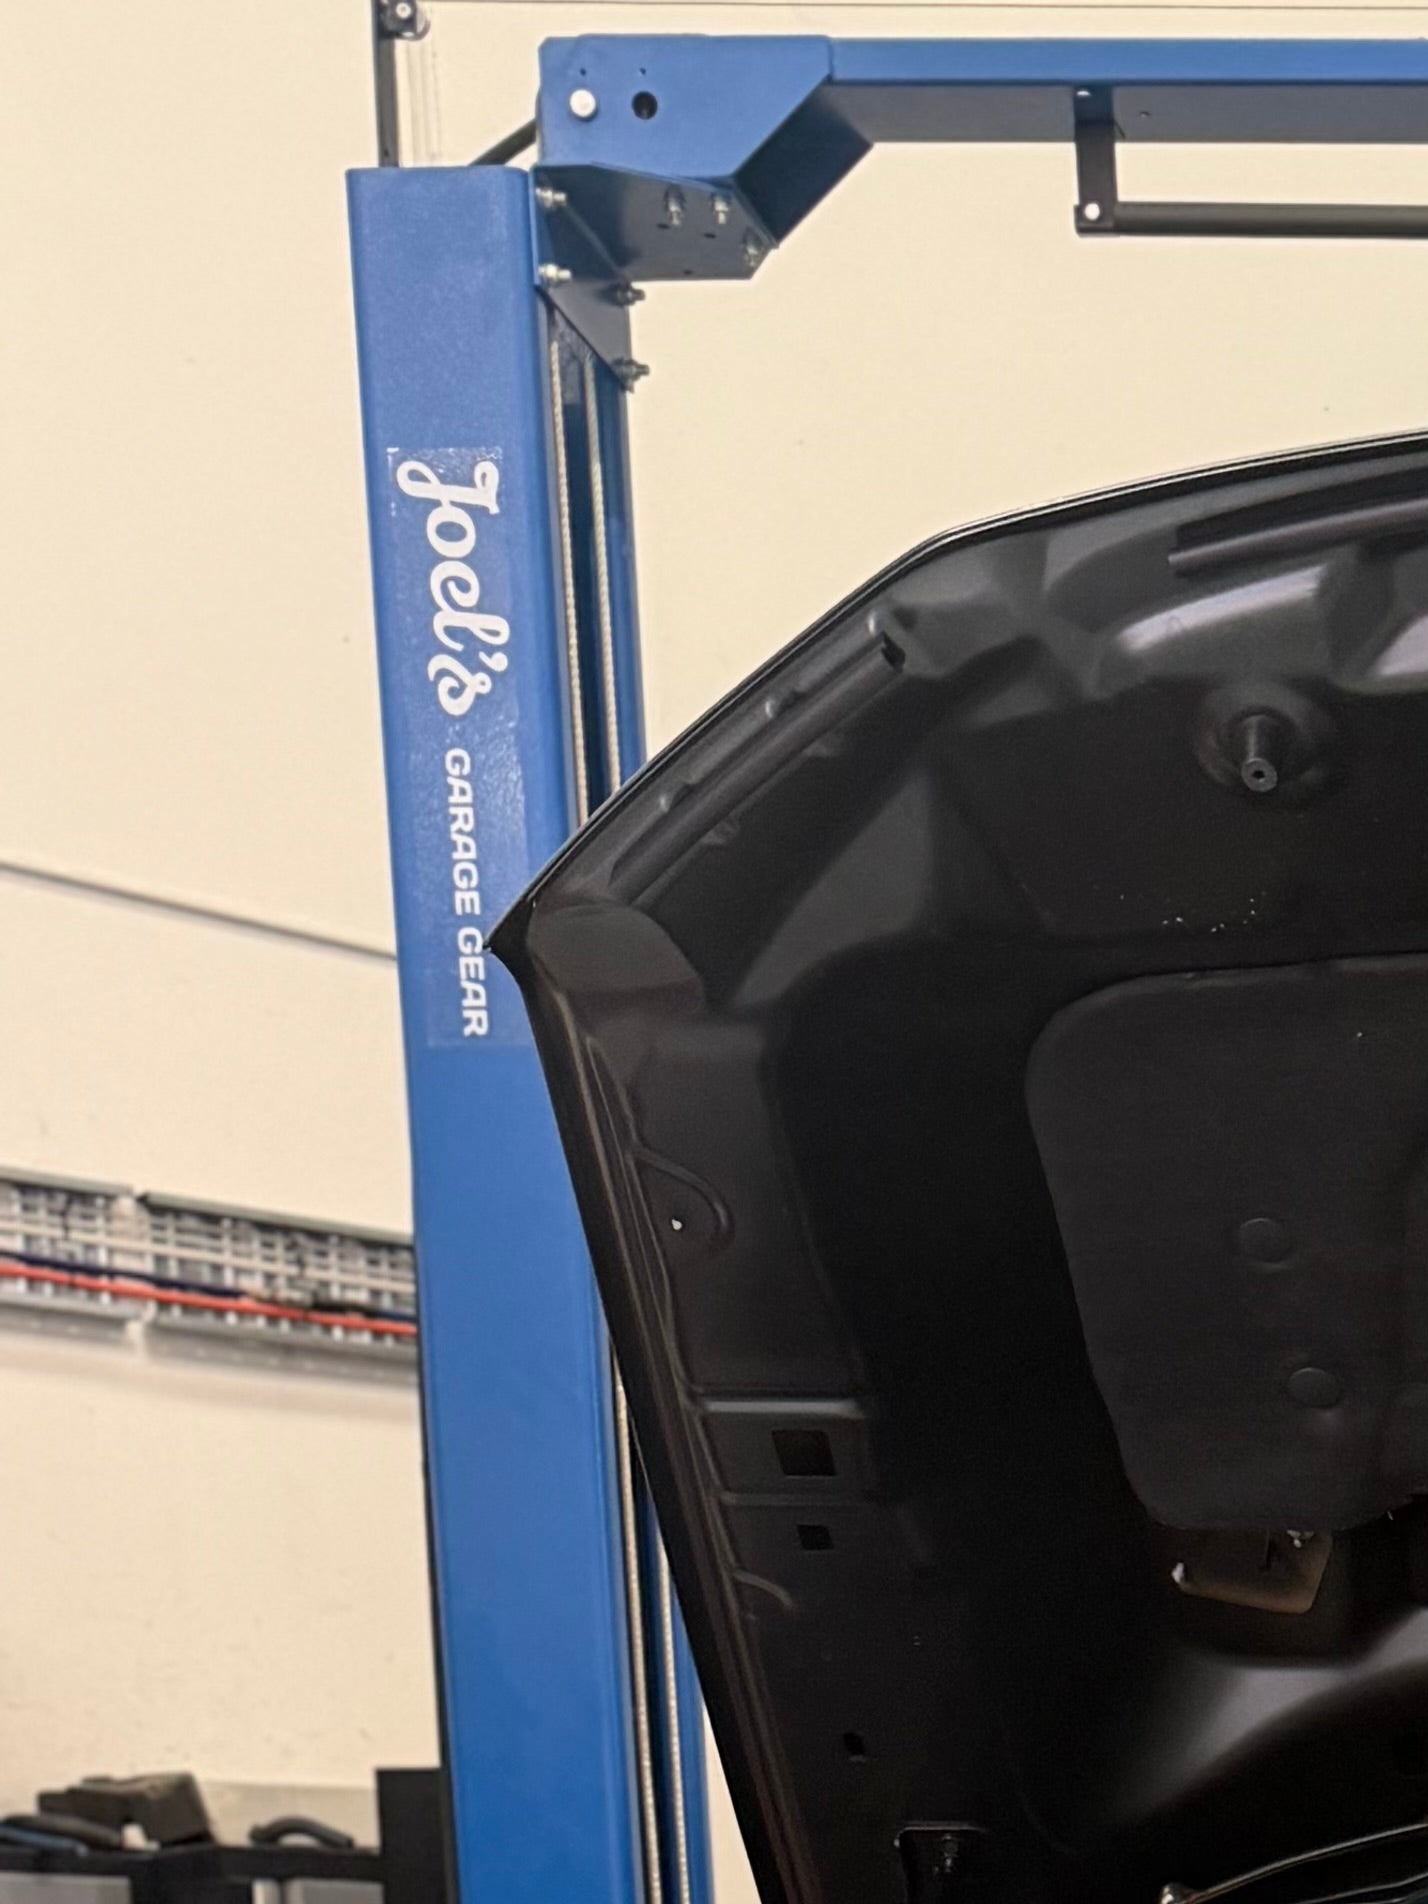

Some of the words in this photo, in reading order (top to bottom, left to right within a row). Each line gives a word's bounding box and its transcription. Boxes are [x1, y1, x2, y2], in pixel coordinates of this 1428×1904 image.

[396, 459, 509, 716] Joel's
[445, 747, 481, 915] GARAGE
[458, 923, 489, 1037] GEAR
